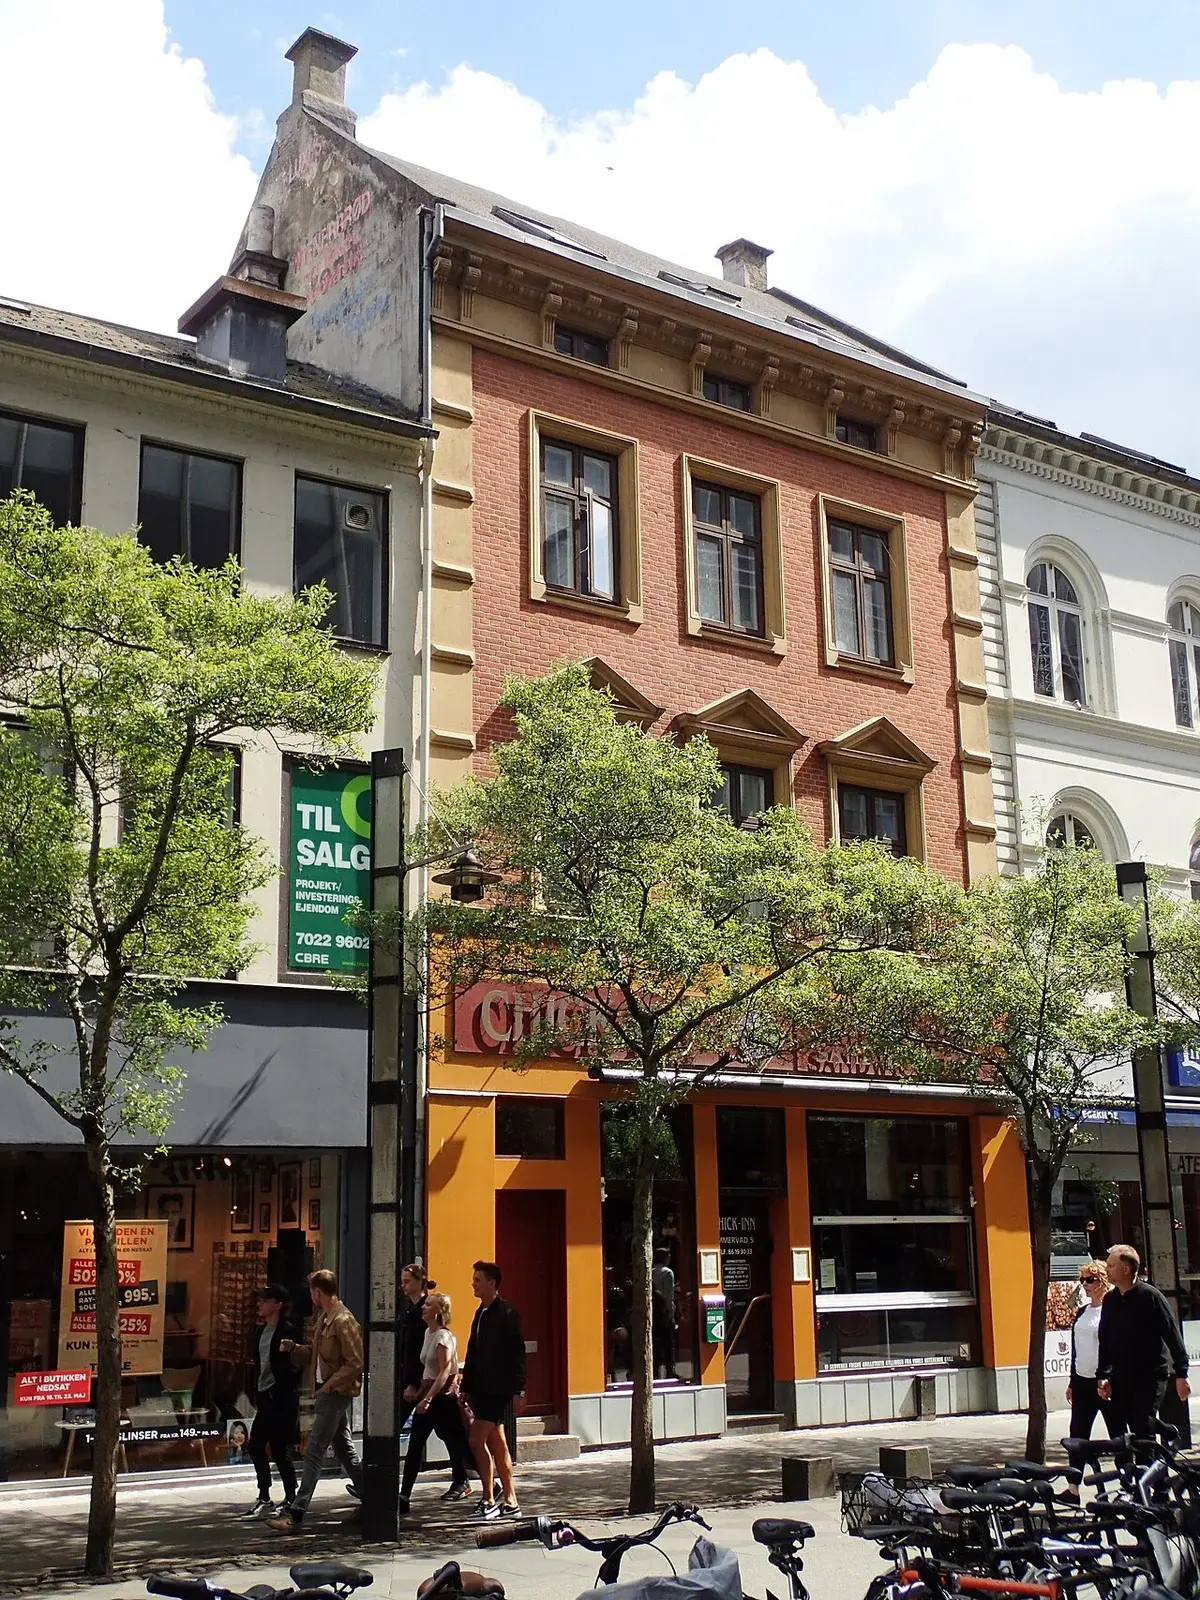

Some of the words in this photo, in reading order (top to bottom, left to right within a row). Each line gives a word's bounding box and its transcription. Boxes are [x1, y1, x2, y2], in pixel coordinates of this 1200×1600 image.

[296, 803, 340, 833] TIL
[296, 838, 370, 871] SALG
[296, 879, 342, 892] PROJEKT-/
[295, 903, 339, 914] EJENDOM
[295, 932, 332, 947] 7022
[335, 935, 370, 949] 9602
[295, 952, 329, 964] CBRE
[718, 1217, 756, 1231] HICK-INN
[124, 1288, 155, 1303] 995,-
[120, 1318, 147, 1332] 25%
[66, 1341, 90, 1350] KUN
[1045, 1358, 1070, 1373] COFF
[21, 1376, 37, 1384] ALT
[44, 1373, 86, 1383] BUTIKKEN
[36, 1383, 70, 1392] NEDSAT
